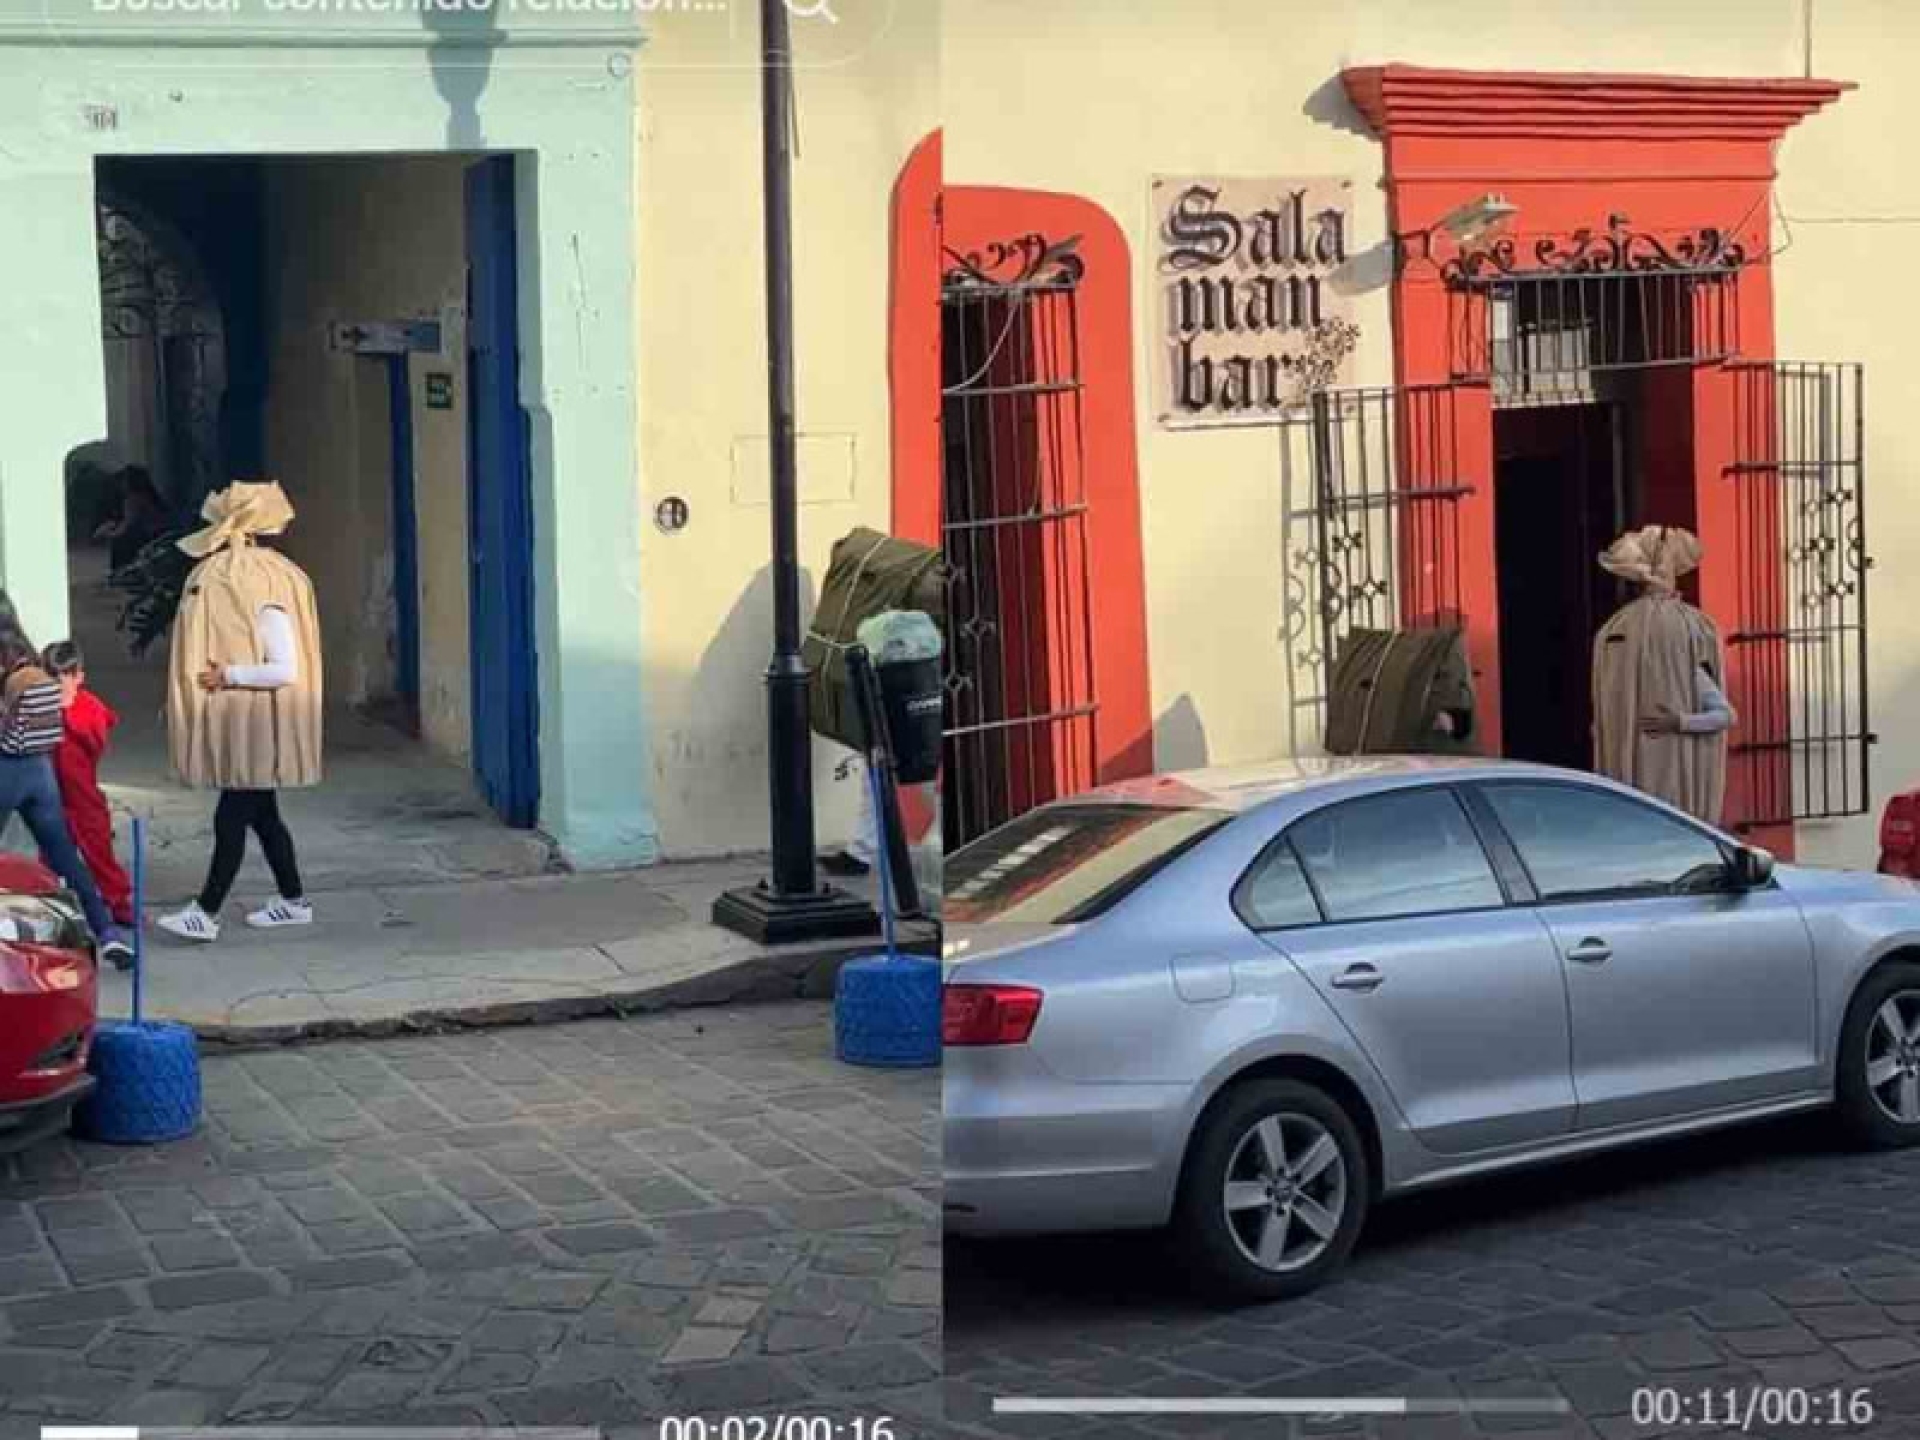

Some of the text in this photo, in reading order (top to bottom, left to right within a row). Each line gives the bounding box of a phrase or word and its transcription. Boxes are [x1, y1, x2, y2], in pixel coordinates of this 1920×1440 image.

[1162, 184, 1345, 268] Sala
[1172, 274, 1321, 332] man
[1173, 335, 1281, 410] bar
